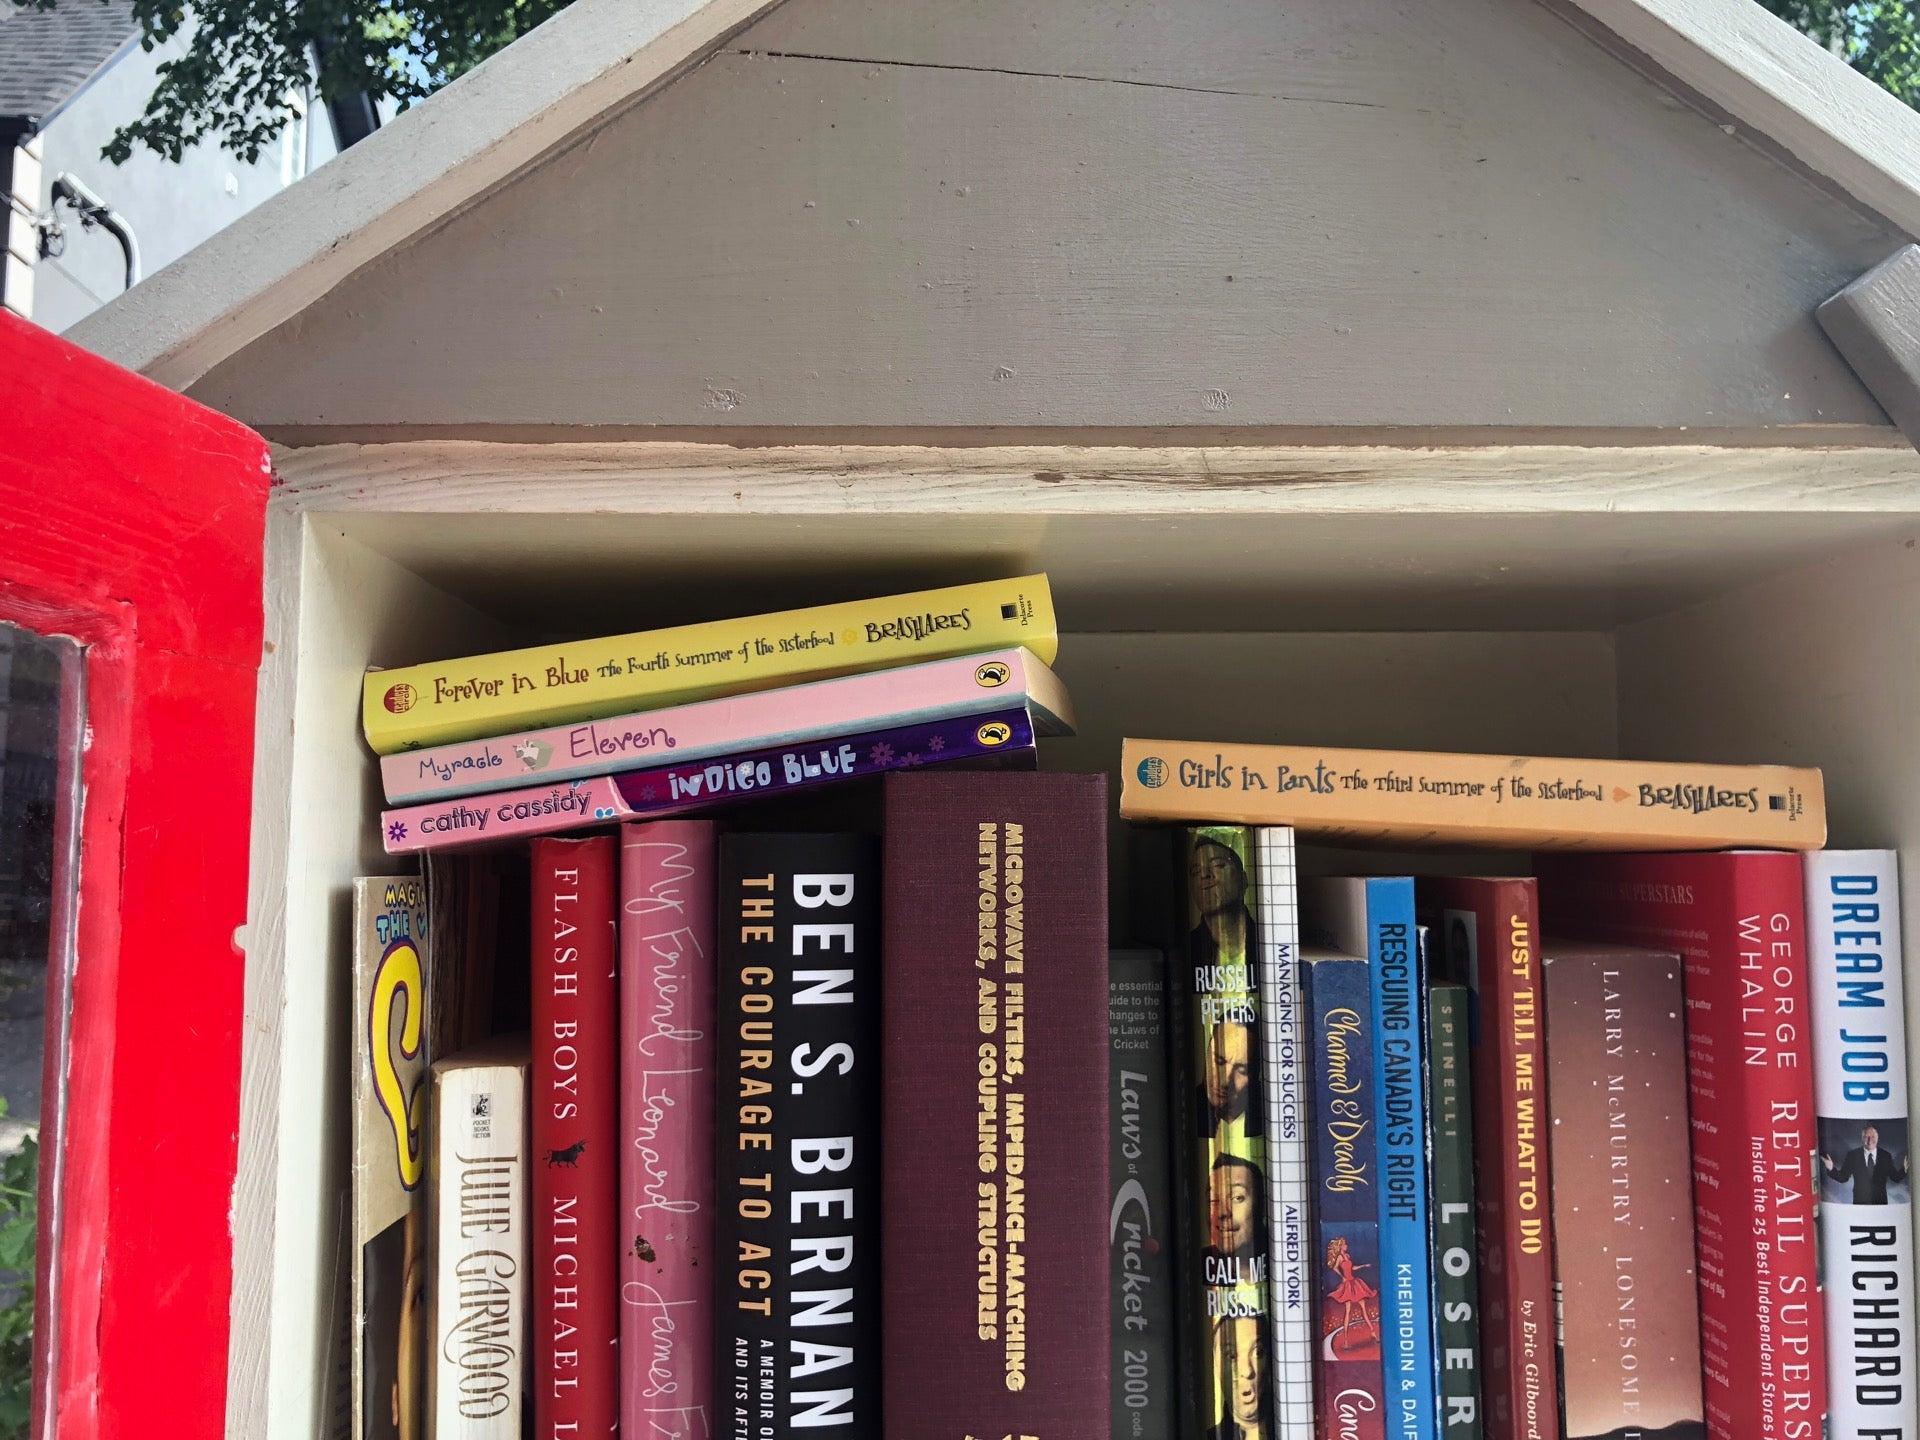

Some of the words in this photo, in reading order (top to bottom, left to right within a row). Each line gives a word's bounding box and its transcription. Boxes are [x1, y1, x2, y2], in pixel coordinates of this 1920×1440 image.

[434, 677, 504, 704] Forever
[512, 672, 536, 695] in
[546, 657, 590, 688] Blue
[597, 660, 623, 679] The
[627, 652, 670, 675] Fourth
[675, 648, 733, 668] Summer
[738, 642, 750, 663] of
[756, 637, 774, 656] the
[864, 608, 972, 644] BRASHARES
[419, 747, 503, 781] Myracle
[570, 725, 677, 758] Eleven
[420, 806, 490, 834] cathy
[497, 788, 593, 822] cassidy
[783, 744, 857, 784] BLUE
[1179, 754, 1233, 789] Girls
[1241, 766, 1266, 791] in
[1276, 759, 1336, 794] Pants
[1340, 769, 1368, 791] The
[1374, 770, 1413, 793] Third
[1419, 776, 1485, 797] Summer
[1490, 776, 1505, 803] of
[1510, 776, 1532, 798] the
[1636, 783, 1759, 815] BRASHARES
[623, 842, 695, 914] My
[741, 873, 775, 943] THE
[975, 822, 997, 970] NETWORKS,
[1005, 822, 1024, 974] MICROWAVE
[376, 909, 411, 944] THE
[554, 867, 578, 997] FLASH
[791, 873, 855, 1005] BEN
[1511, 914, 1530, 980] JUST
[1830, 875, 1885, 1008] DREAM
[638, 926, 705, 1057] Friend
[978, 977, 997, 1034] AND
[1119, 981, 1163, 991] essential
[1131, 996, 1142, 1005] to
[1144, 996, 1160, 1006] the
[1195, 963, 1257, 993] RUSSELL
[1200, 997, 1257, 1025] PETERS
[1277, 943, 1293, 1033] MANAGING
[1379, 923, 1409, 1031] RESCUING
[1738, 914, 1768, 1066] WHALIN
[1770, 913, 1797, 1068] GEORGE
[1002, 982, 1025, 1084] FILTERS,
[1113, 1038, 1150, 1049] Cricket
[1121, 1025, 1147, 1035] Laws
[1150, 1025, 1160, 1035] of
[1148, 1011, 1158, 1020] to
[1513, 986, 1536, 1046] TELL
[1603, 970, 1623, 1058] LARRY
[553, 1019, 578, 1120] BOYS
[739, 966, 774, 1150] COURAGE
[790, 1042, 855, 1095] S.
[1280, 1037, 1293, 1069] FOR
[1323, 1007, 1362, 1094] Charmed
[1441, 1005, 1457, 1136] SPINELLI
[1515, 1053, 1533, 1091] ME
[1839, 1028, 1890, 1102] JOB
[978, 1042, 997, 1174] COUPLING
[1120, 1070, 1148, 1159] Laws
[1281, 1071, 1296, 1139] SUCCESS
[1330, 1099, 1363, 1118] &
[1383, 1039, 1415, 1150] CANADA'S
[635, 1067, 704, 1220] Leonard
[1127, 1163, 1138, 1175] of
[1325, 1120, 1370, 1193] Deadly
[1517, 1098, 1535, 1172] WHAT
[1607, 1075, 1631, 1227] McMURTRY
[1750, 1136, 1765, 1183] Inside
[455, 1151, 518, 1239] JULIE
[738, 1173, 772, 1219] TO
[1386, 1155, 1417, 1222] RIGHT
[1518, 1175, 1537, 1210] TO
[1752, 1187, 1765, 1213] the
[1771, 1100, 1805, 1253] RETAIL
[978, 1182, 997, 1341] STRUCTURES
[1005, 1093, 1025, 1392] IMPEDANCE-MATCHING
[1110, 1178, 1152, 1331] Cricket
[1285, 1204, 1299, 1262] ALFRED
[1520, 1218, 1542, 1255] DO
[1753, 1218, 1766, 1236] 25
[1756, 1241, 1770, 1276] Best
[553, 1196, 578, 1398] MICHAEL
[738, 1240, 772, 1316] ACT
[790, 1136, 854, 1428] BERNAN
[1205, 1255, 1245, 1285] CALL
[1249, 1252, 1268, 1283] ME
[1207, 1286, 1267, 1318] RUSSELL
[1286, 1266, 1300, 1309] YORK
[444, 1249, 516, 1419] GARWOOD
[622, 1281, 698, 1398] James
[760, 1339, 774, 1348] A
[1397, 1263, 1415, 1371] KHEIRIDDIN
[1441, 1202, 1475, 1427] LOSER
[1520, 1300, 1535, 1317] by
[1522, 1321, 1537, 1358] Eric
[1615, 1256, 1640, 1415] LONESOME
[1757, 1279, 1775, 1378] Independent
[1850, 1225, 1902, 1406] RICHARD
[735, 1337, 748, 1368] AND
[735, 1375, 748, 1401] ITS
[760, 1356, 774, 1419] MEMOIR
[1124, 1350, 1148, 1408] 2000
[1401, 1379, 1416, 1391] &
[1778, 1275, 1812, 1440] SUPERS
[760, 1426, 774, 1440] O
[1132, 1411, 1142, 1437] code
[1524, 1360, 1541, 1440] Gilboord
[1762, 1382, 1776, 1432] Stores
